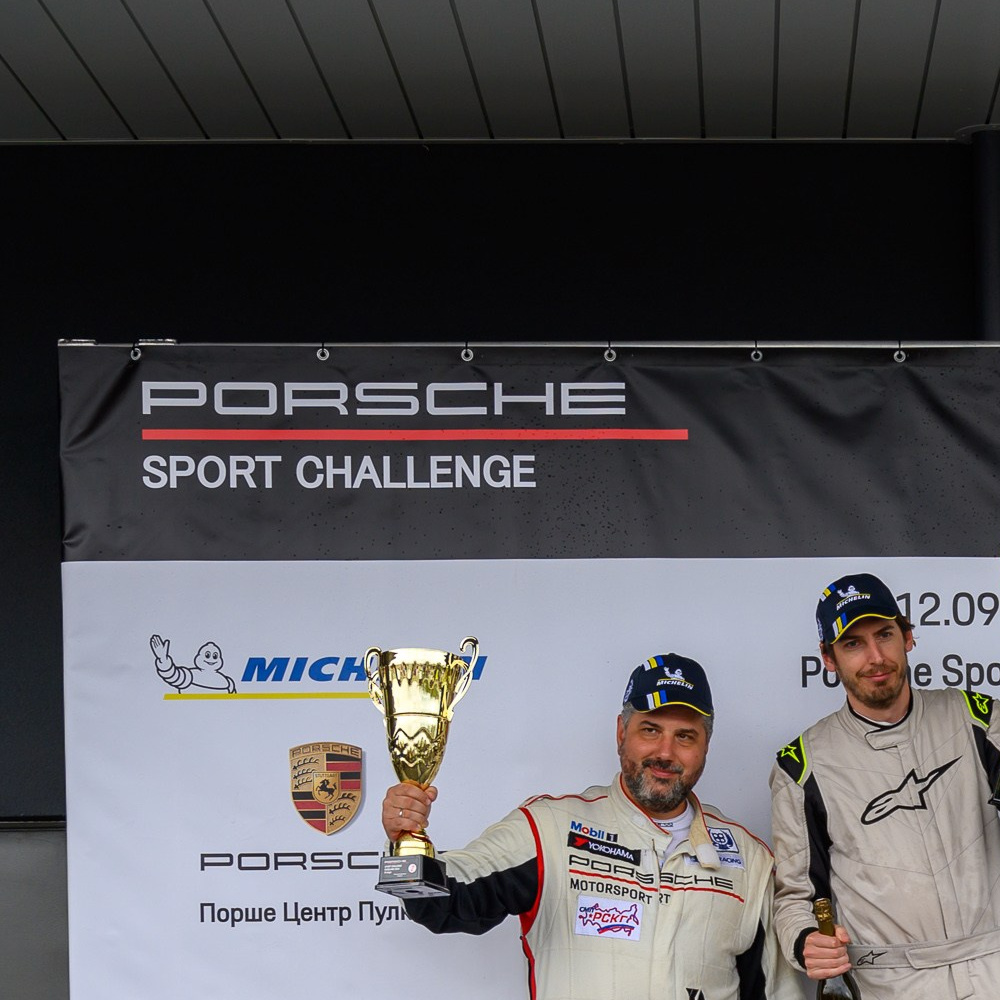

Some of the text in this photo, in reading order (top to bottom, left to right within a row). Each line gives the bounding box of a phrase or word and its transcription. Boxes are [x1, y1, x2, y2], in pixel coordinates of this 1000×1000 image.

[142, 382, 625, 415] PORSCHE
[143, 455, 536, 488] SPORT CHALLENGE
[656, 680, 693, 690] MICHELIN
[292, 744, 360, 757] PORSCHE
[570, 821, 604, 839] Mobil
[588, 841, 634, 861] YOKOHAMA
[200, 903, 276, 927] Порше
[284, 902, 351, 926] Центр
